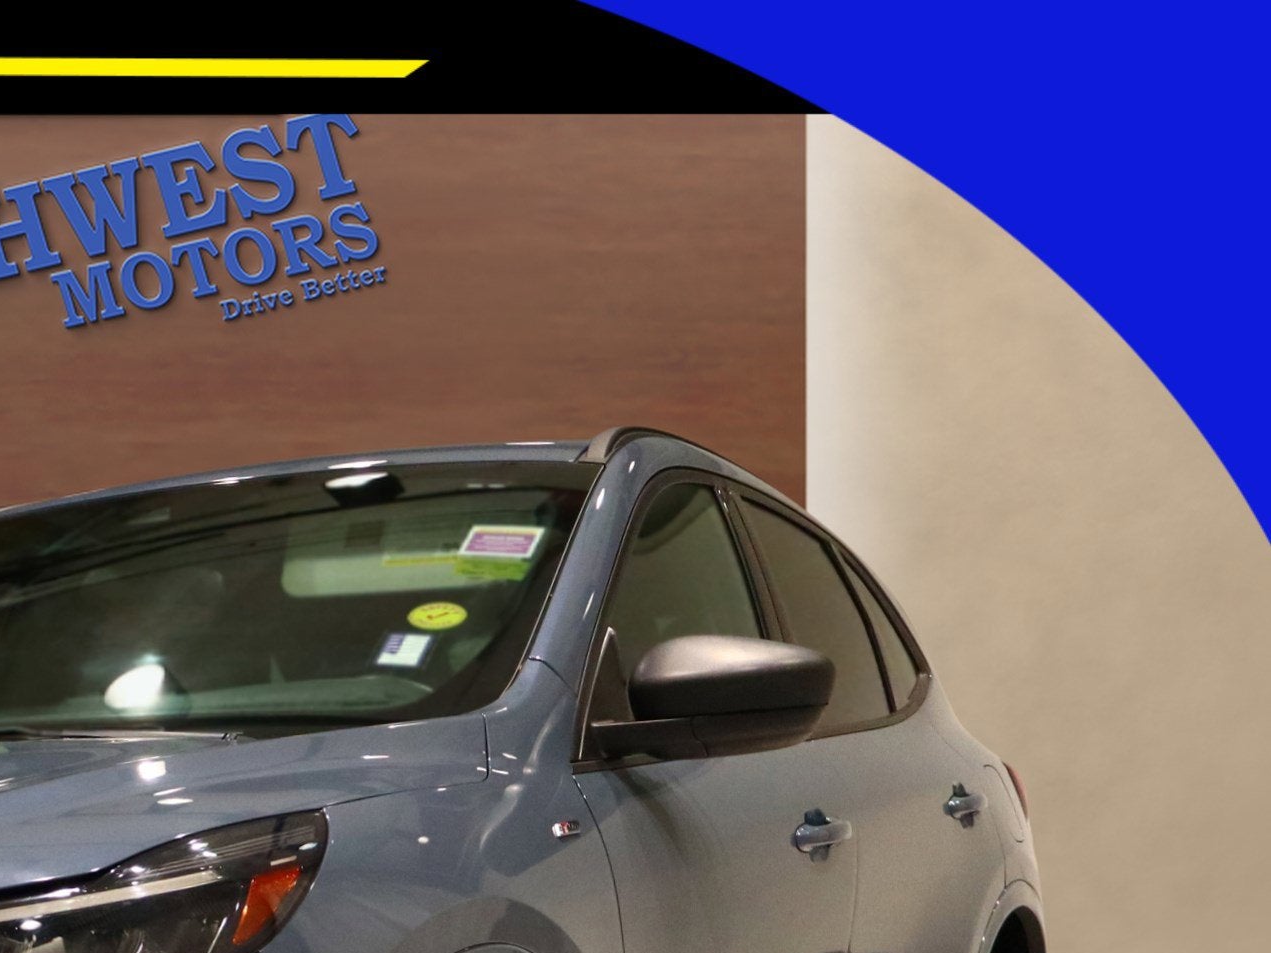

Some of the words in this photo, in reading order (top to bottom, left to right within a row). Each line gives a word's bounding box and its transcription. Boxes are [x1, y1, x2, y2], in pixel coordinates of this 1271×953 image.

[51, 203, 378, 328] MOTORS
[219, 289, 294, 321] Drive
[300, 265, 387, 301] Better
